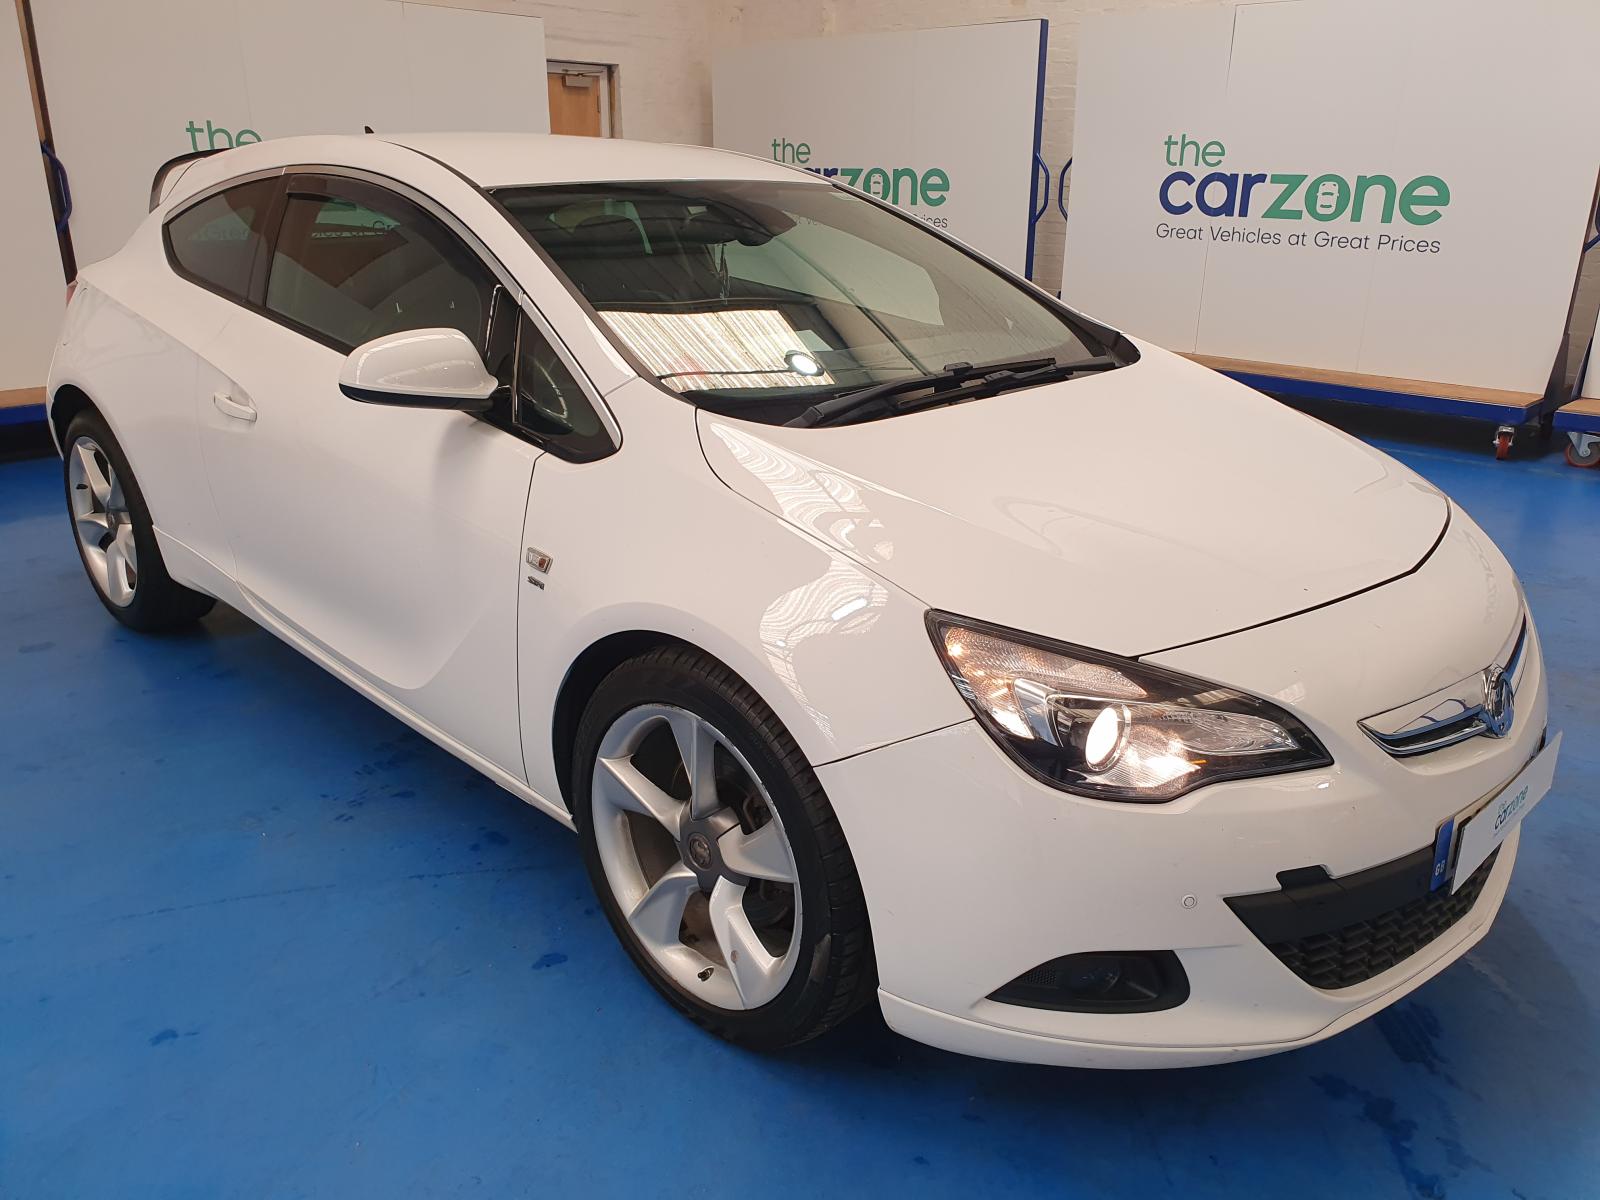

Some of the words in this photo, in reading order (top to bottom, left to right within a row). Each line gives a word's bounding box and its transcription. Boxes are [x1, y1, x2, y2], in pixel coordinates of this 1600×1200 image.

[771, 138, 811, 163] the
[1164, 134, 1226, 167] the
[1159, 171, 1450, 226] carzone
[1156, 223, 1203, 240] Great
[1210, 226, 1281, 245] Vehicles
[1287, 232, 1307, 247] at
[1314, 231, 1370, 250] Great
[1377, 234, 1441, 254] Prices
